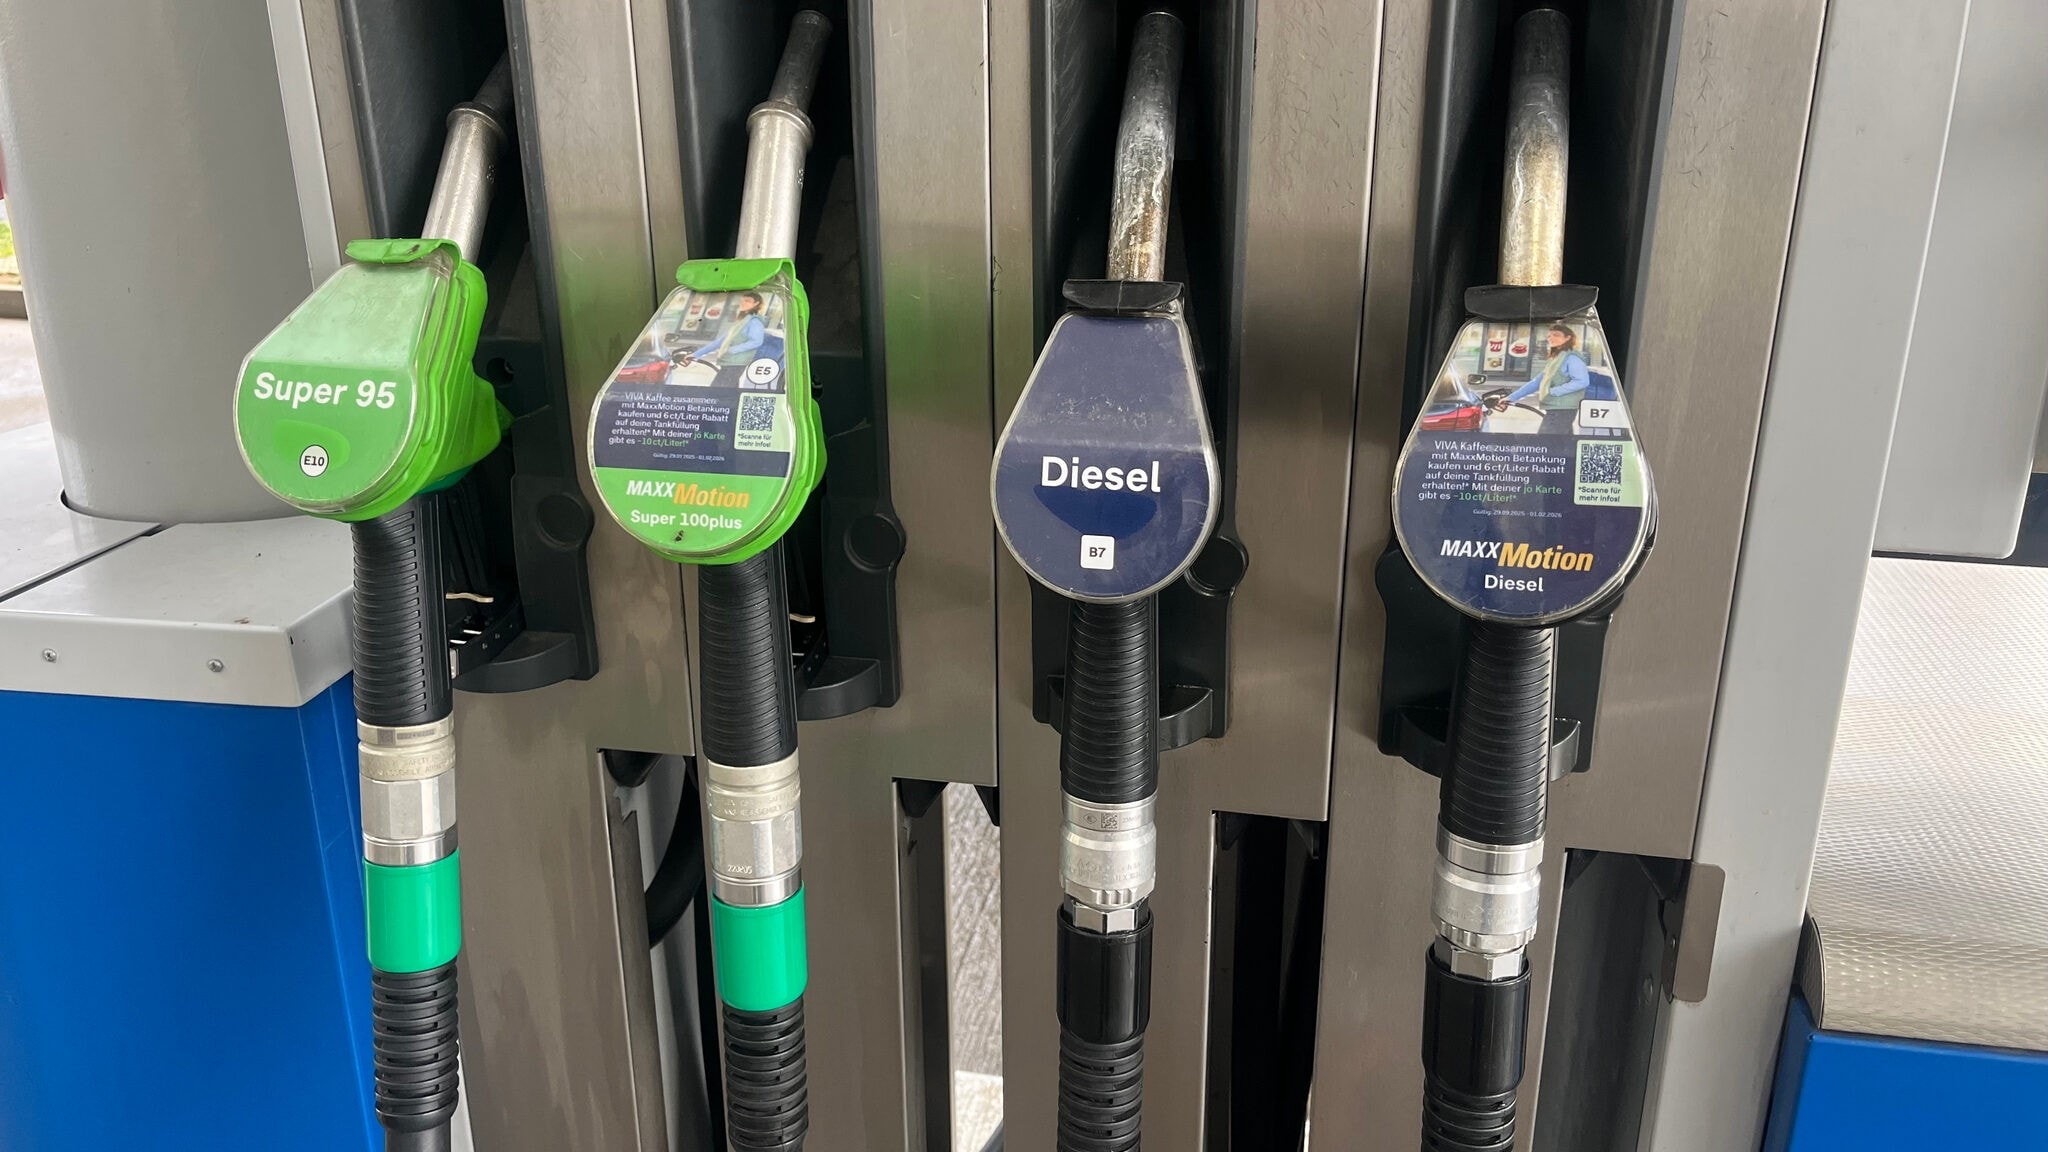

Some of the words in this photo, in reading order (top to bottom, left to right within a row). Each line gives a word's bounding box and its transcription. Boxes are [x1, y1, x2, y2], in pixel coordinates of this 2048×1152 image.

[755, 366, 771, 376] E5
[253, 371, 347, 409] Super
[355, 379, 397, 409] 95
[625, 392, 644, 401] VIVA
[646, 393, 672, 402] Kaffee
[637, 402, 685, 411] MaxxMotion
[687, 404, 730, 414] Betankung
[1590, 408, 1610, 419] B7
[618, 410, 645, 418] kaufen
[647, 411, 661, 419] und
[702, 414, 729, 422] Rabatt
[608, 436, 624, 445] gibt
[653, 429, 666, 437] Mit
[668, 430, 693, 438] deiner
[703, 431, 726, 440] Karte
[1434, 440, 1458, 450] VIVA
[1460, 441, 1493, 452] Kaffee
[1494, 445, 1548, 454] zusammen
[303, 455, 325, 467] E10
[1431, 452, 1448, 460] mit
[1450, 452, 1510, 462] MaxxMotion
[1512, 454, 1566, 466] Betankung
[1428, 461, 1461, 470] kaufen
[1463, 463, 1482, 471] und
[1531, 464, 1565, 474] Rabatt
[1041, 455, 1161, 493] Diesel
[1425, 471, 1441, 480] auf
[1443, 472, 1470, 480] deine
[1471, 483, 1488, 491] Mit
[1490, 484, 1522, 493] deiner
[1535, 485, 1562, 494] Karte
[1418, 491, 1437, 501] gibt
[630, 509, 676, 527] Super
[679, 512, 742, 530] 100plus
[1089, 547, 1106, 558] B7
[1484, 574, 1544, 592] Diesel
